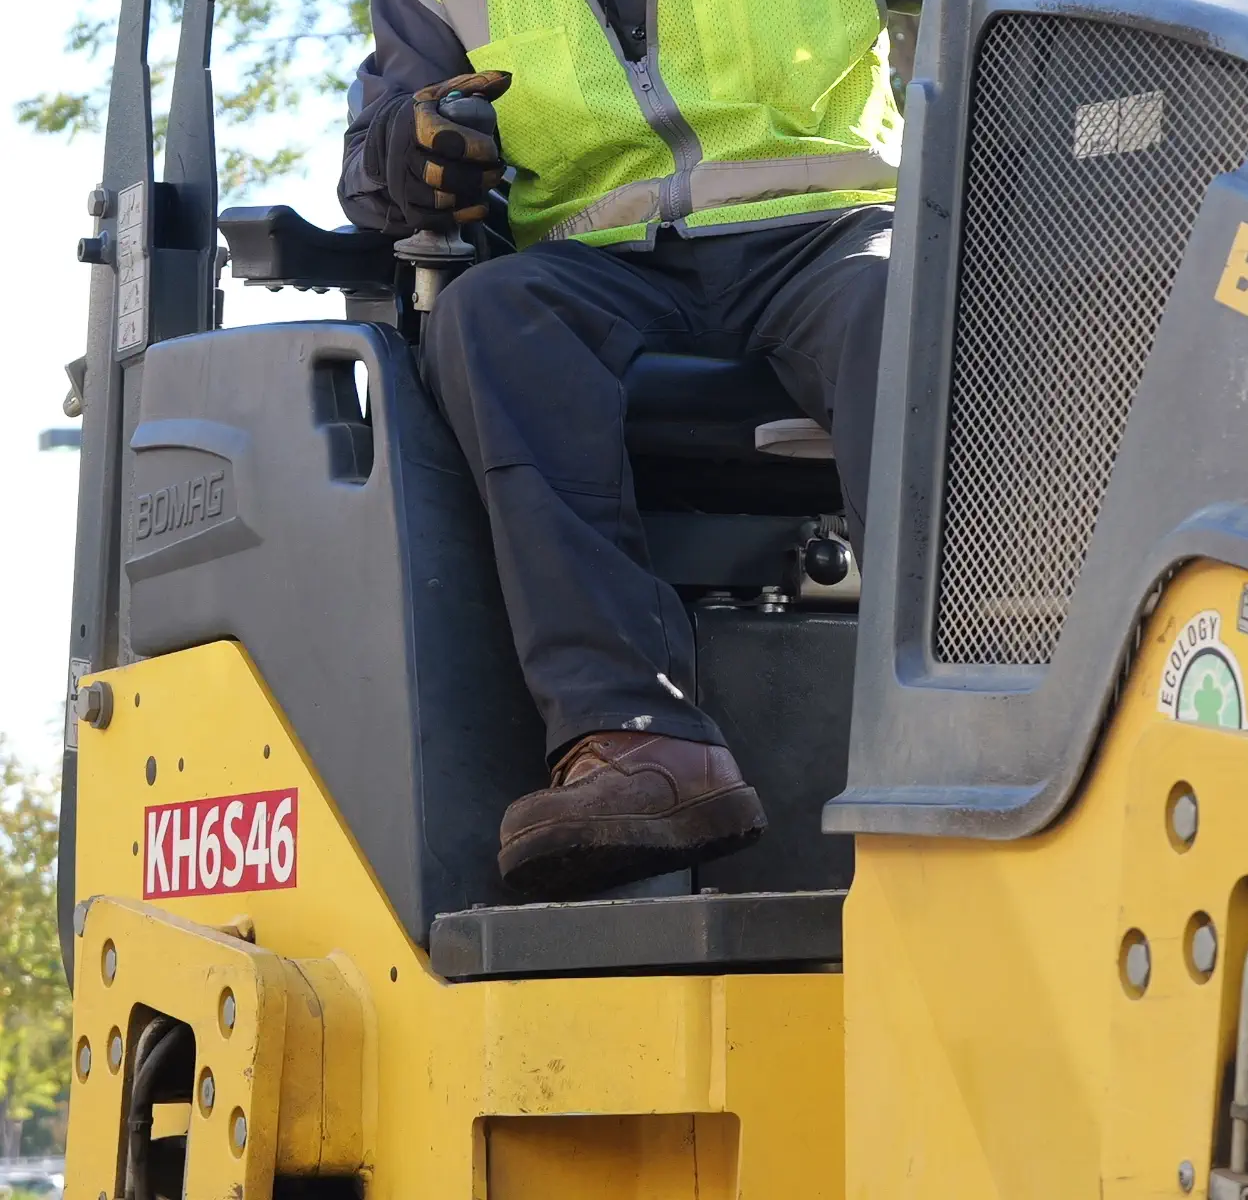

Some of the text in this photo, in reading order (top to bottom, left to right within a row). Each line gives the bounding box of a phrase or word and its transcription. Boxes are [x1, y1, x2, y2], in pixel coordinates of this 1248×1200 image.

[136, 470, 224, 541] BOMAG
[1162, 616, 1218, 706] ECOLOGY
[146, 797, 295, 894] KH6S46
